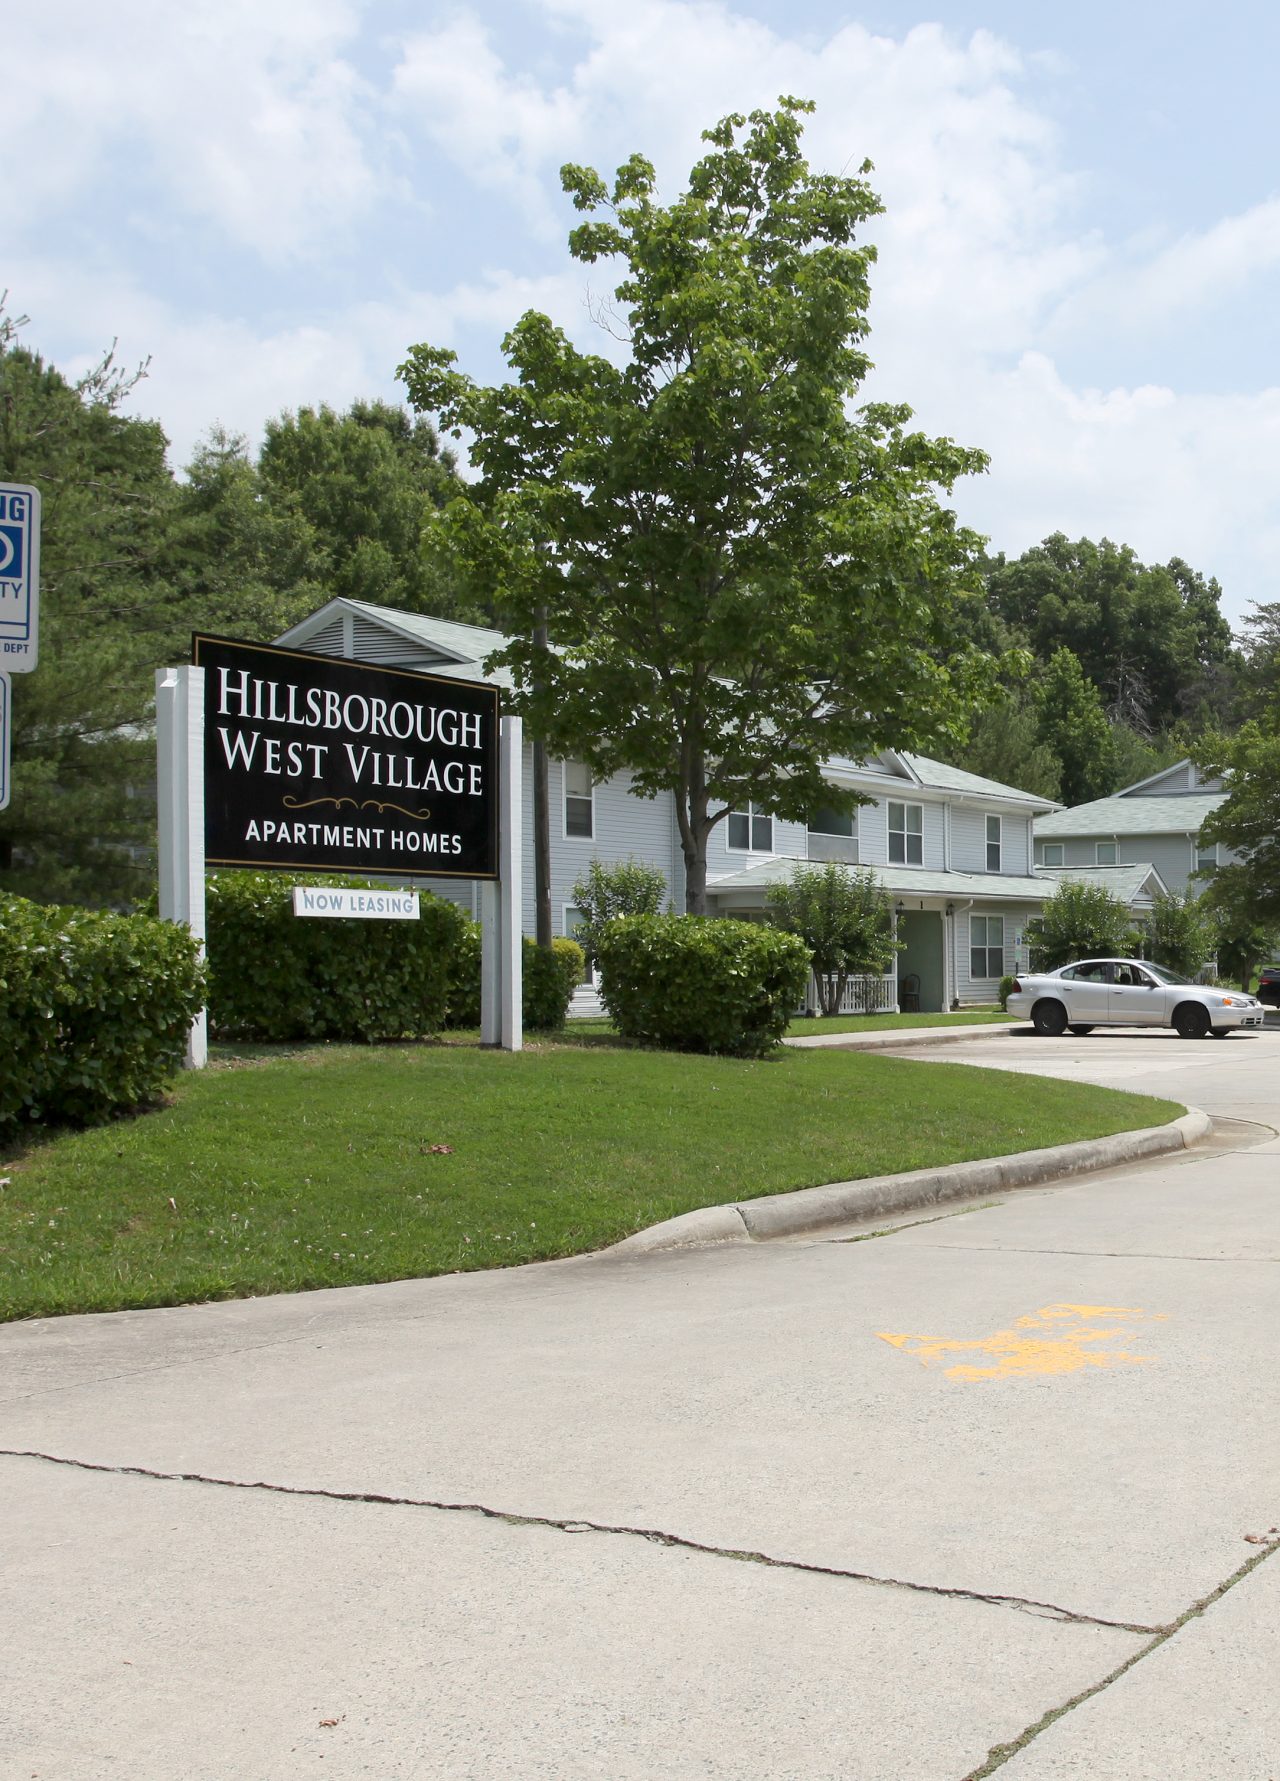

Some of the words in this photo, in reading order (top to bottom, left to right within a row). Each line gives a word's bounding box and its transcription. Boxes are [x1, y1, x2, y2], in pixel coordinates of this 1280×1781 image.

[4, 642, 30, 654] DEPT
[217, 666, 483, 750] HILLSBOROUGH
[217, 727, 329, 780] WEST
[342, 743, 483, 796] VILLAGE
[245, 819, 385, 849] APARTMENT
[390, 831, 462, 855] HOMES
[304, 894, 343, 911] NOW
[350, 896, 414, 914] LEASING
